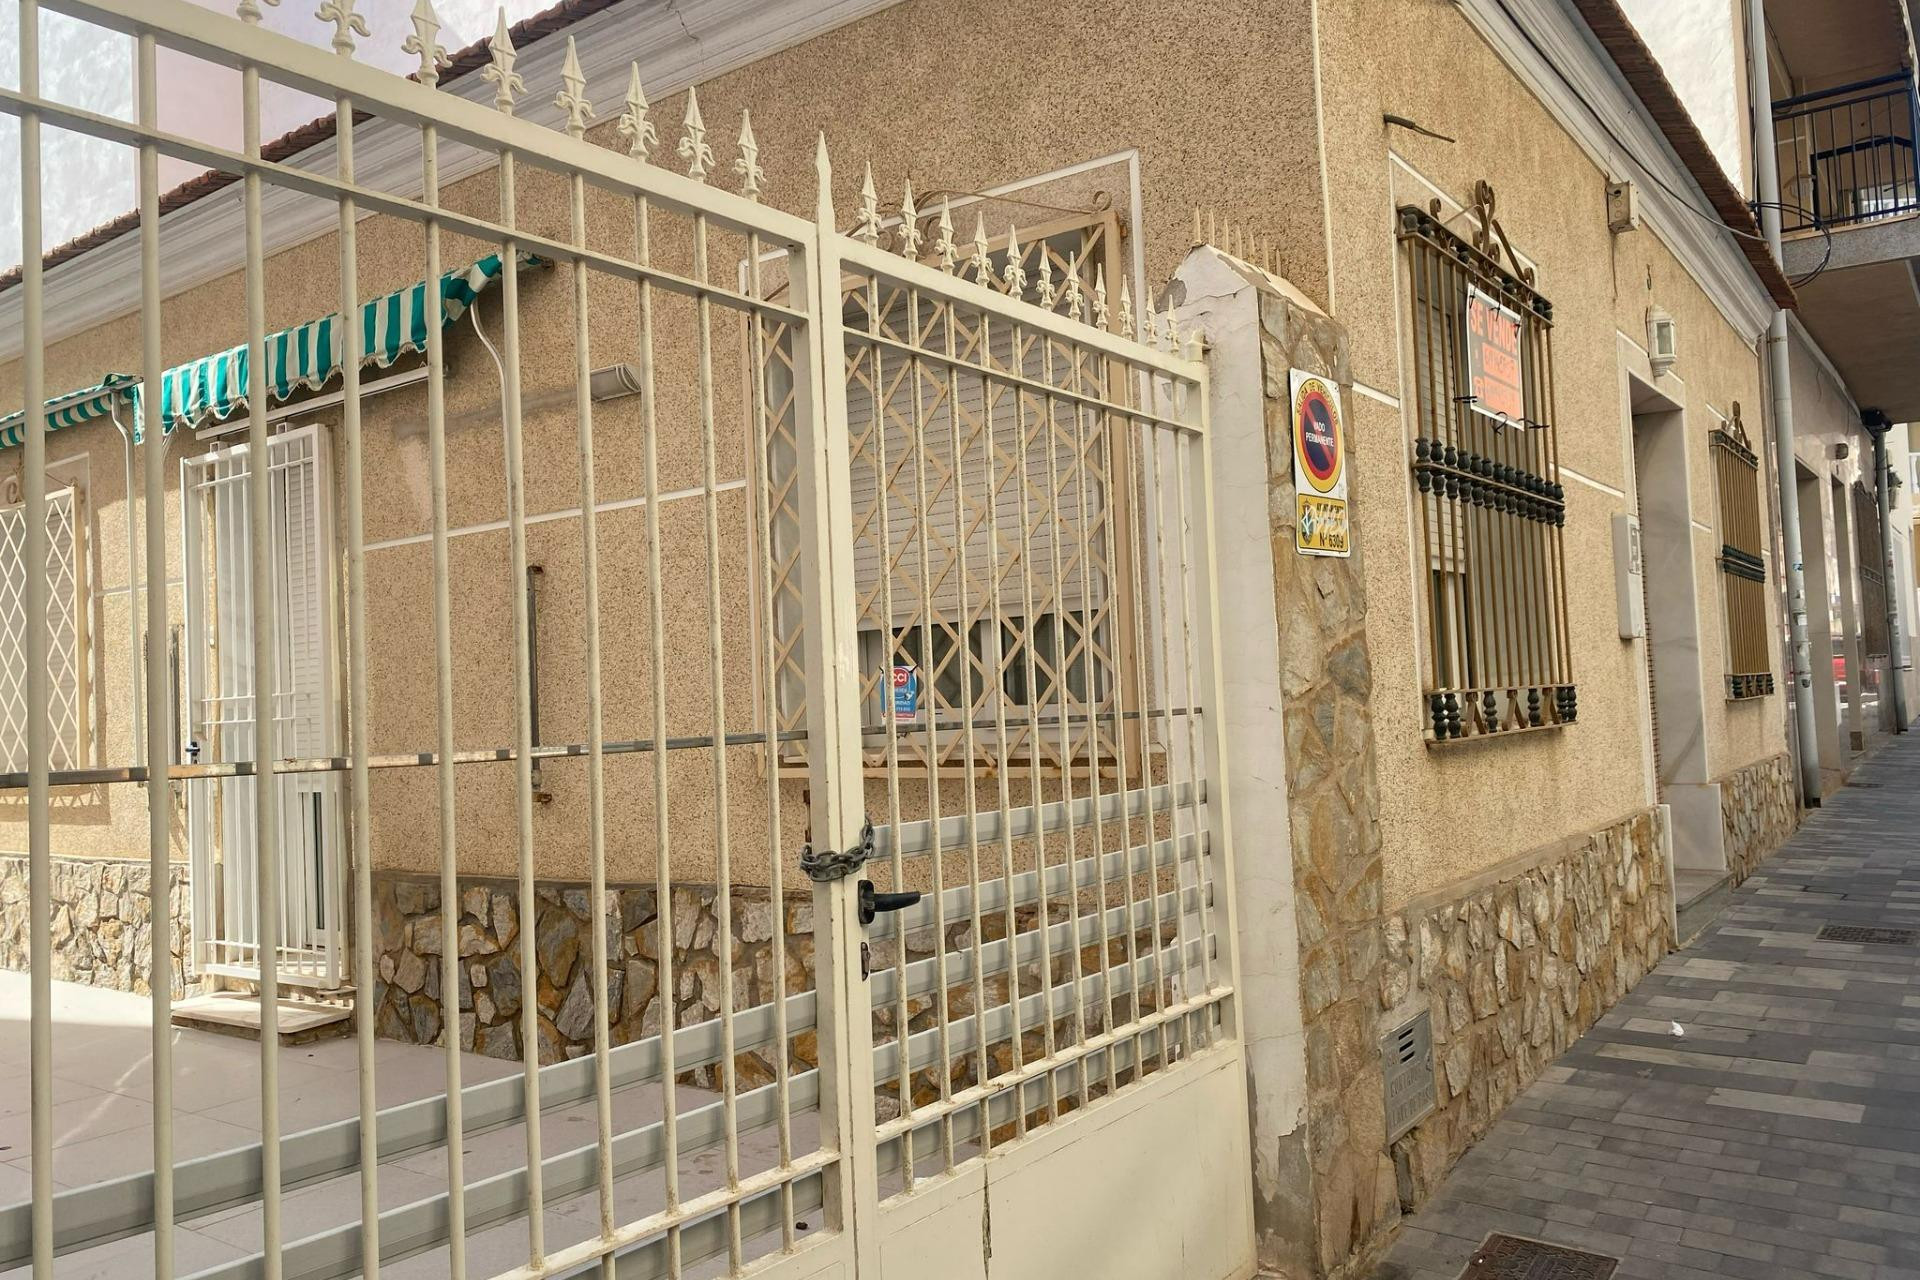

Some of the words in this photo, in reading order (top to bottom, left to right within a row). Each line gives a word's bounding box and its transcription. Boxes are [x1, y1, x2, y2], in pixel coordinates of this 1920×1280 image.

[1470, 298, 1483, 337] SE
[1485, 305, 1518, 357] VENDE
[1296, 387, 1308, 416] SALIDA
[1308, 381, 1316, 391] DE
[1305, 431, 1335, 448] PERMANENTE
[1313, 421, 1326, 433] VADO
